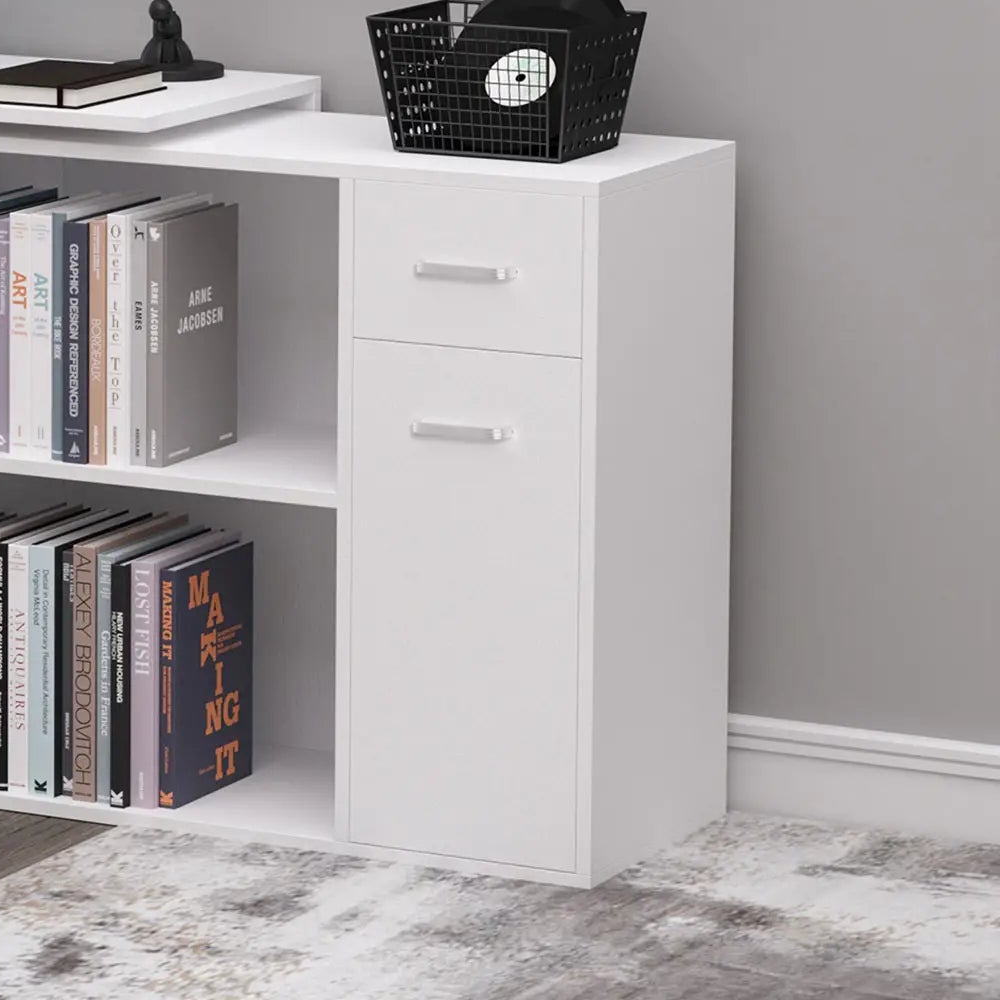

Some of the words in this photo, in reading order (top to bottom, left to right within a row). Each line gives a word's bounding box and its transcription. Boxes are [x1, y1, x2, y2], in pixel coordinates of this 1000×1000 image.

[69, 243, 79, 295] GRAPHIC
[110, 223, 121, 281] Over
[12, 270, 27, 309] ART
[33, 273, 49, 311] ART
[150, 280, 159, 306] ARNE
[188, 286, 213, 308] ARNE
[69, 297, 79, 340] DESIGN
[134, 300, 142, 331] EAMES
[150, 307, 159, 354] JACOBSEN
[176, 306, 224, 335] JACOBSEN
[91, 318, 101, 382] BORDEAUX
[69, 343, 79, 417] REFERENCED
[75, 552, 92, 638] ALEXEY
[135, 569, 150, 624] LOST
[162, 580, 173, 640] MAKING
[41, 598, 49, 650] Contemporary
[13, 608, 25, 730] ANTIQUAIRES
[101, 631, 110, 679] Gardens
[135, 629, 150, 675] FISH
[162, 645, 172, 661] IT
[101, 681, 110, 692] in
[75, 644, 92, 786] BRODOVITCH
[100, 696, 110, 737] France
[215, 740, 239, 781] IT
